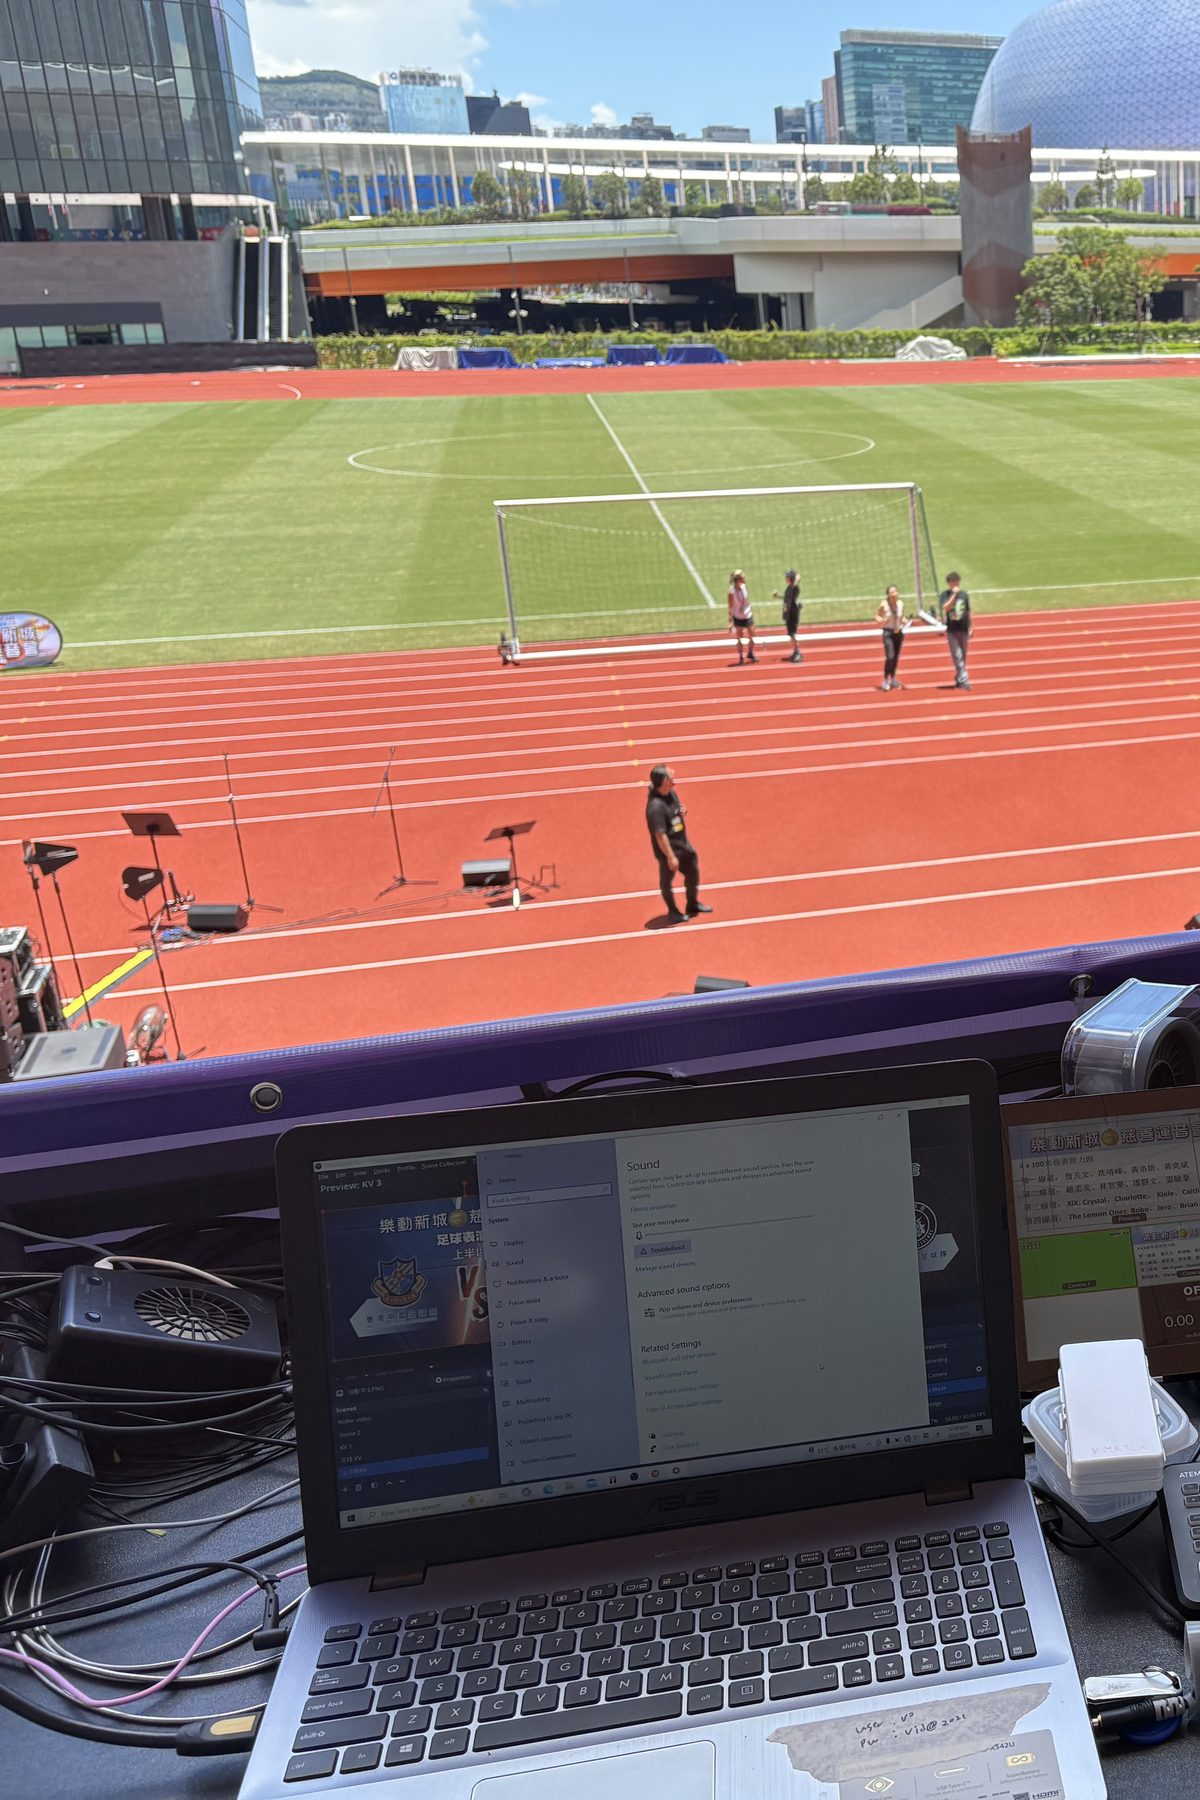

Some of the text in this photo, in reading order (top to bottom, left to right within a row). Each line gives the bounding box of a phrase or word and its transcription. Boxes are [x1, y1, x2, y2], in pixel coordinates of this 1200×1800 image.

[626, 1158, 661, 1172] Sound
[320, 1179, 383, 1193] Preview: KV 3
[1068, 1213, 1082, 1222] The
[1083, 1209, 1108, 1220] Lemon
[488, 1216, 510, 1225] System
[503, 1239, 525, 1248] Display
[505, 1258, 525, 1267] Sound
[549, 1274, 569, 1282] actions
[637, 1281, 731, 1299] Advanced sound options
[659, 1305, 671, 1315] App
[672, 1303, 693, 1312] volume
[1164, 1314, 1195, 1328] 0.00
[641, 1339, 703, 1353] Related Settings
[899, 1538, 919, 1547] home
[732, 1584, 740, 1592] 0
[694, 1590, 702, 1598] 9
[656, 1597, 664, 1605] 8
[618, 1603, 624, 1612] 7
[752, 1606, 759, 1614] P
[872, 1608, 890, 1616] enter
[578, 1610, 585, 1618] 6
[711, 1612, 722, 1620] O
[538, 1616, 546, 1624] 5
[498, 1622, 506, 1630] 4
[634, 1624, 644, 1633] U
[457, 1628, 466, 1636] 3
[595, 1631, 603, 1640] Y
[416, 1635, 425, 1644] 2
[555, 1637, 564, 1646] T
[514, 1644, 522, 1652] R
[682, 1642, 691, 1651] K
[472, 1650, 480, 1659] E
[644, 1649, 650, 1658] J
[429, 1657, 442, 1666] W
[601, 1656, 612, 1664] H
[387, 1664, 399, 1673] Q
[560, 1662, 571, 1671] G
[520, 1669, 528, 1678] F
[660, 1672, 672, 1682] M
[823, 1671, 835, 1681] ctrl
[477, 1676, 487, 1685] D
[619, 1679, 630, 1688] N
[435, 1683, 444, 1692] S
[579, 1686, 587, 1696] B
[392, 1690, 402, 1698] A
[537, 1693, 546, 1702] V
[493, 1700, 504, 1710] C
[450, 1708, 460, 1717] X
[408, 1714, 417, 1724] Z
[855, 1720, 885, 1736] user
